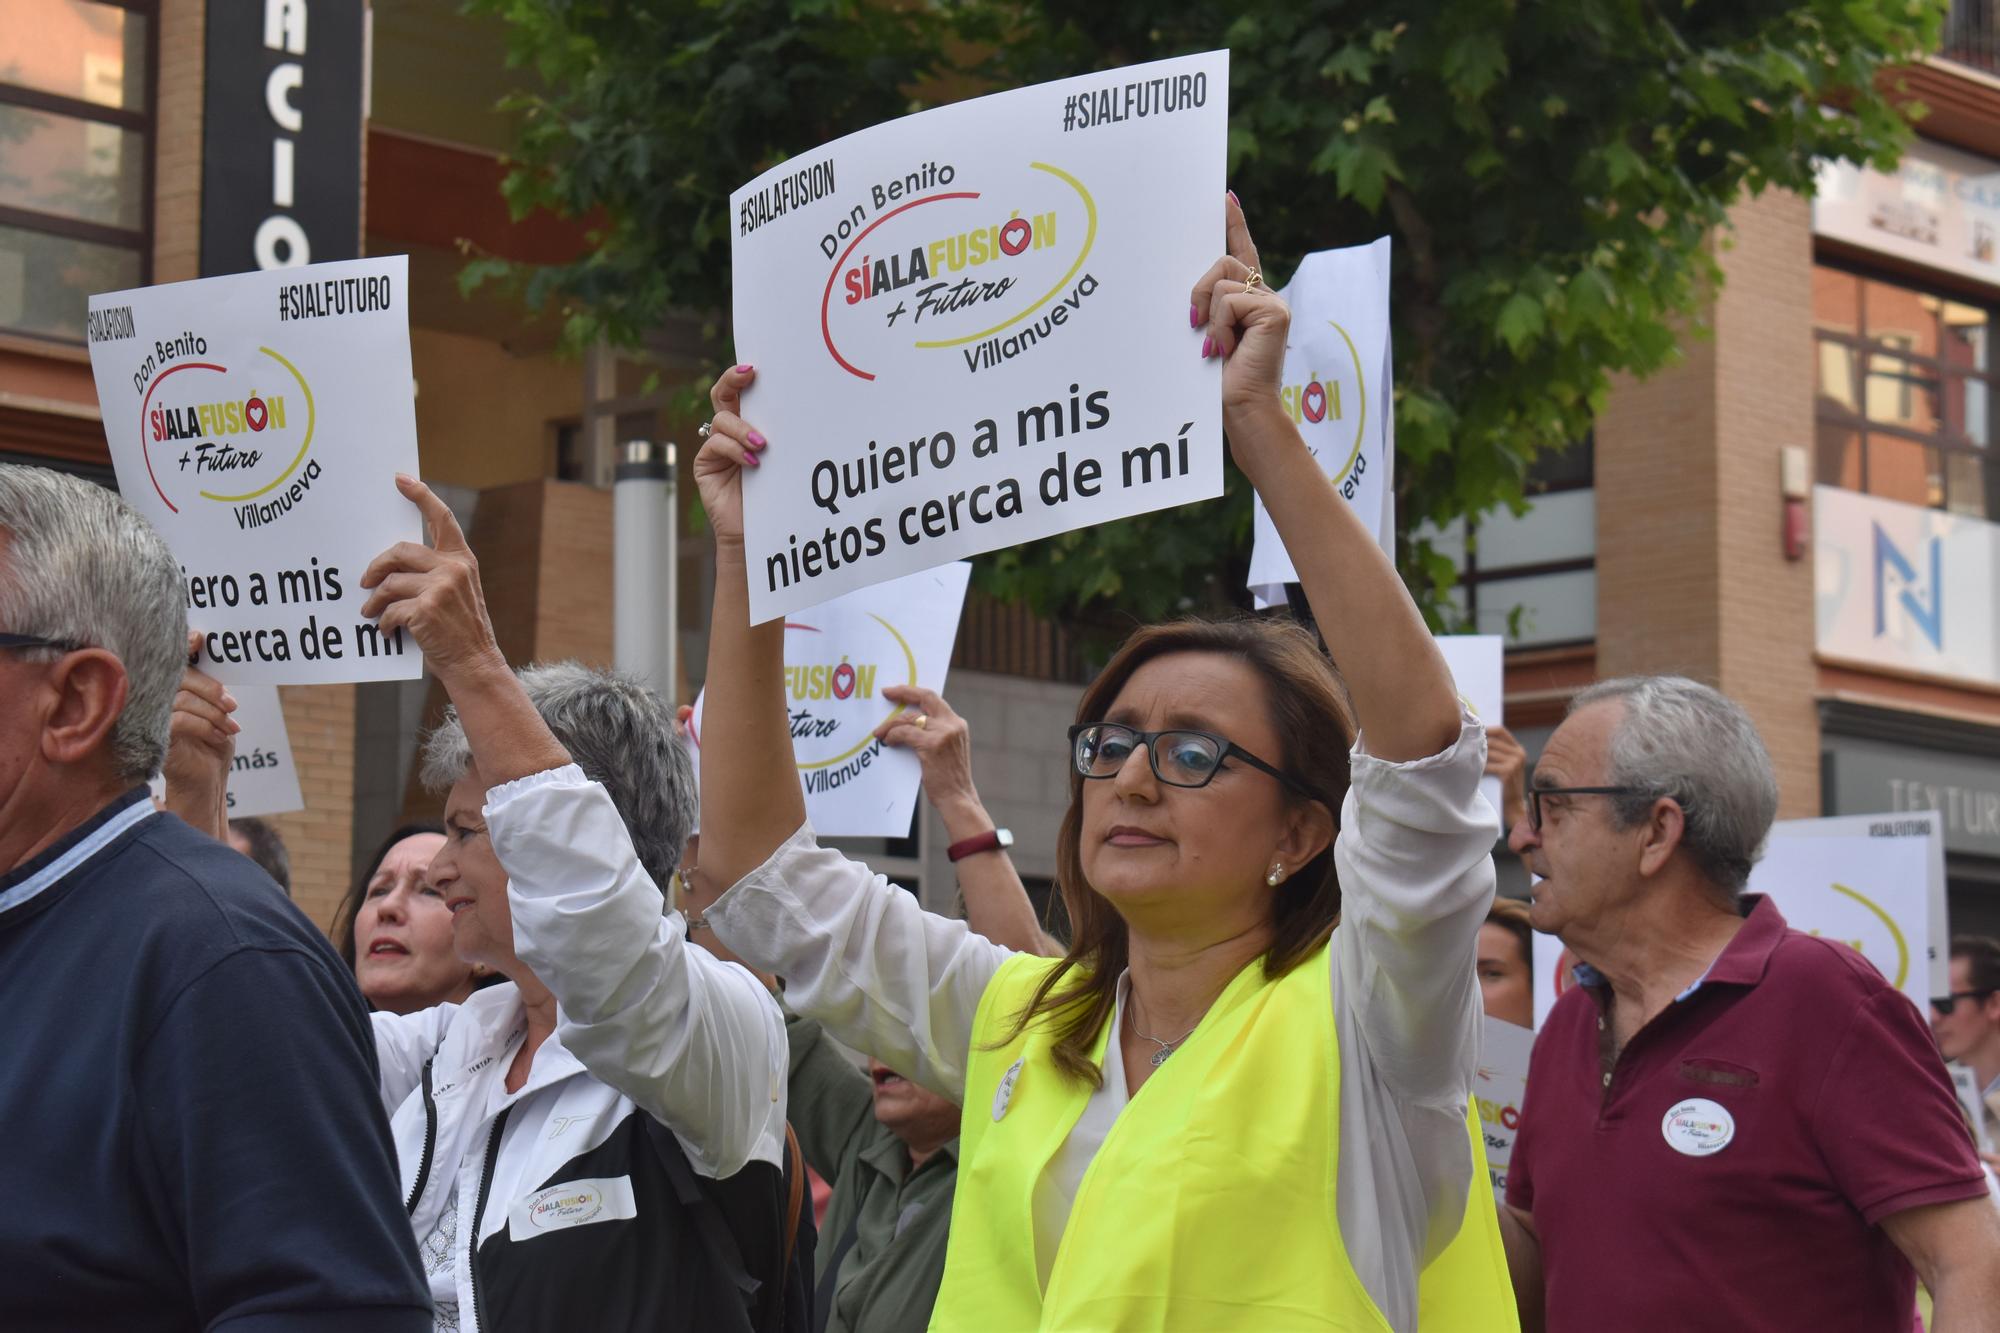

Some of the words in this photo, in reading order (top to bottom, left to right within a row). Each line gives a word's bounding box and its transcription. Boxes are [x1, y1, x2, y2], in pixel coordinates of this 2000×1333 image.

[1063, 71, 1207, 133] #SIALFUTURO
[740, 158, 836, 238] #SIALAFUSION
[820, 203, 866, 260] Don
[871, 161, 956, 211] Benito
[279, 275, 391, 321] #SIALFUTURO
[914, 275, 1018, 325] Futuro
[963, 272, 1099, 373] Villanueva
[133, 354, 157, 396] Don
[156, 331, 207, 365] Benito
[195, 443, 263, 475] Futuro
[811, 431, 956, 516] Quiero
[971, 418, 999, 458] a
[1017, 383, 1110, 447] mis
[234, 458, 322, 530] Villanueva
[766, 517, 886, 593] nietos
[898, 477, 1022, 546] cerca
[1039, 452, 1102, 507] de
[1121, 421, 1195, 489] mí
[181, 565, 239, 609] iero
[250, 570, 268, 606] a
[277, 557, 343, 604] mis
[206, 626, 291, 663] cerca
[300, 615, 343, 660] de
[784, 656, 877, 700] FUSIÓN
[787, 707, 841, 738] turo
